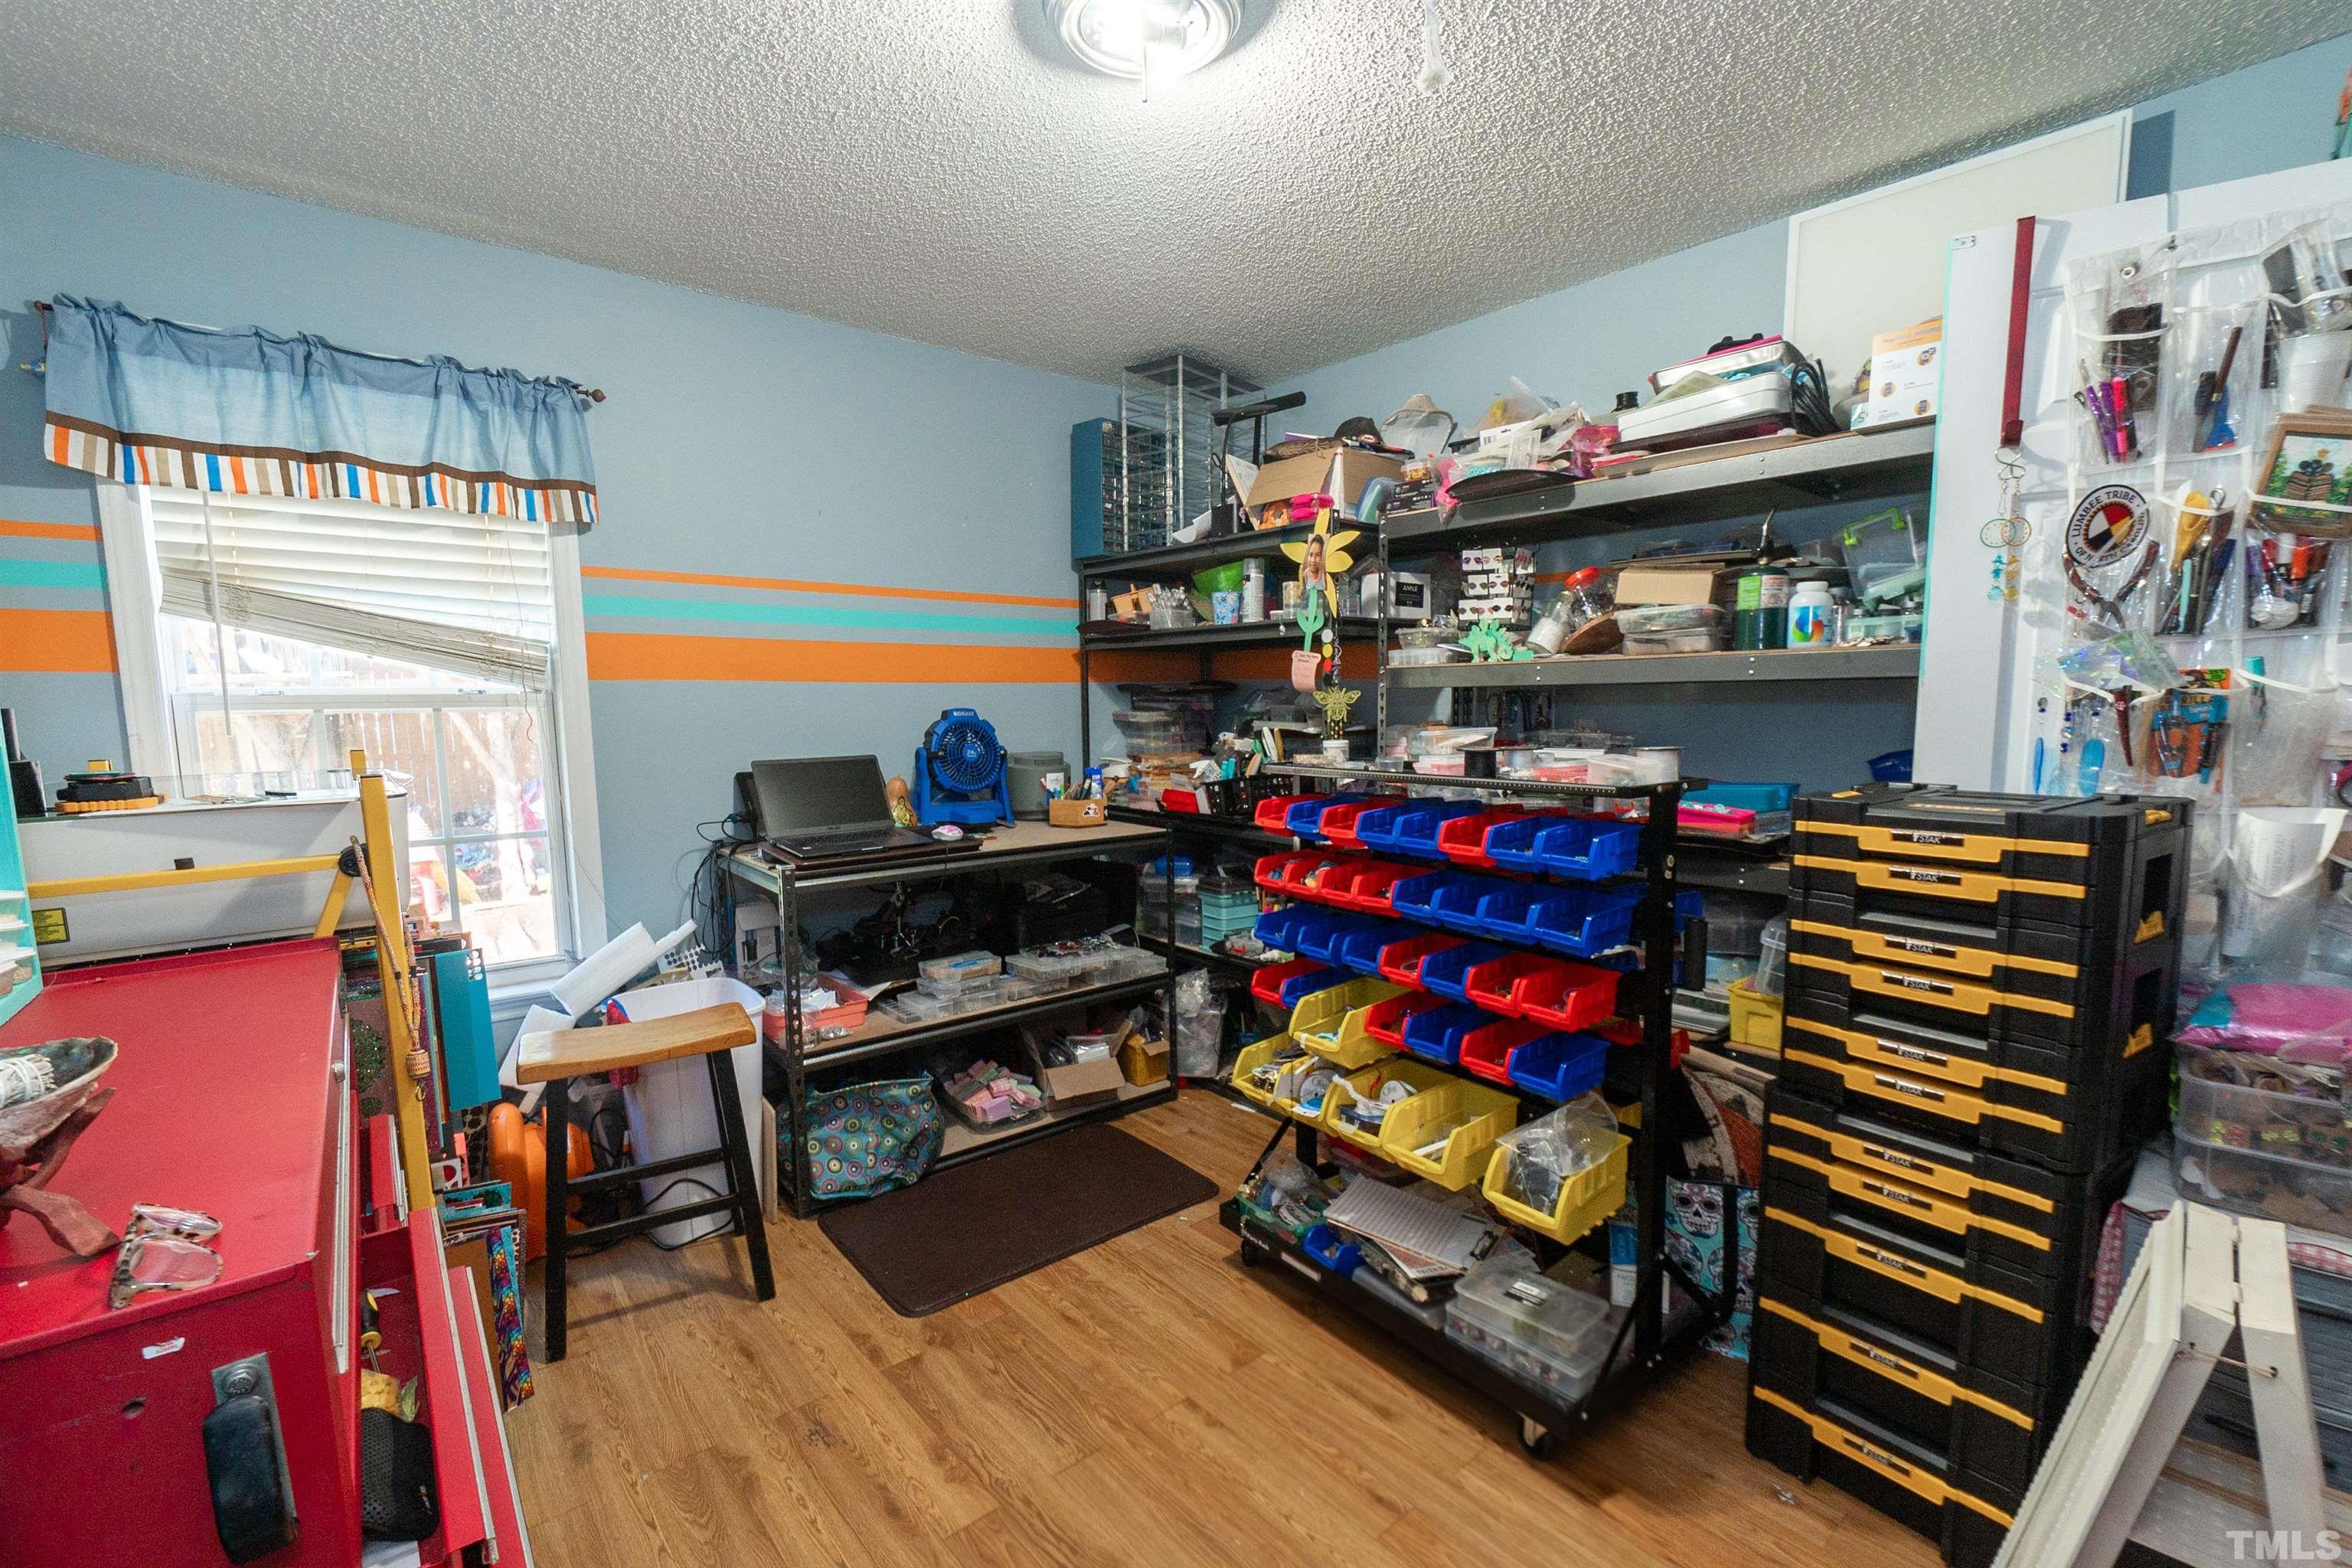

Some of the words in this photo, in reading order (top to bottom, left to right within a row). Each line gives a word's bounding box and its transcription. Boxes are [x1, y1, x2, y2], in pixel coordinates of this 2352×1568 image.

[2071, 495, 2103, 537] LUMBEE
[2105, 490, 2137, 504] TRIBE
[2075, 547, 2087, 557] OF
[1912, 835, 1941, 844] TSTAK
[1909, 872, 1939, 882] TSTAK
[1905, 942, 1933, 954] TSTAK
[1897, 1047, 1924, 1061] TSTAK
